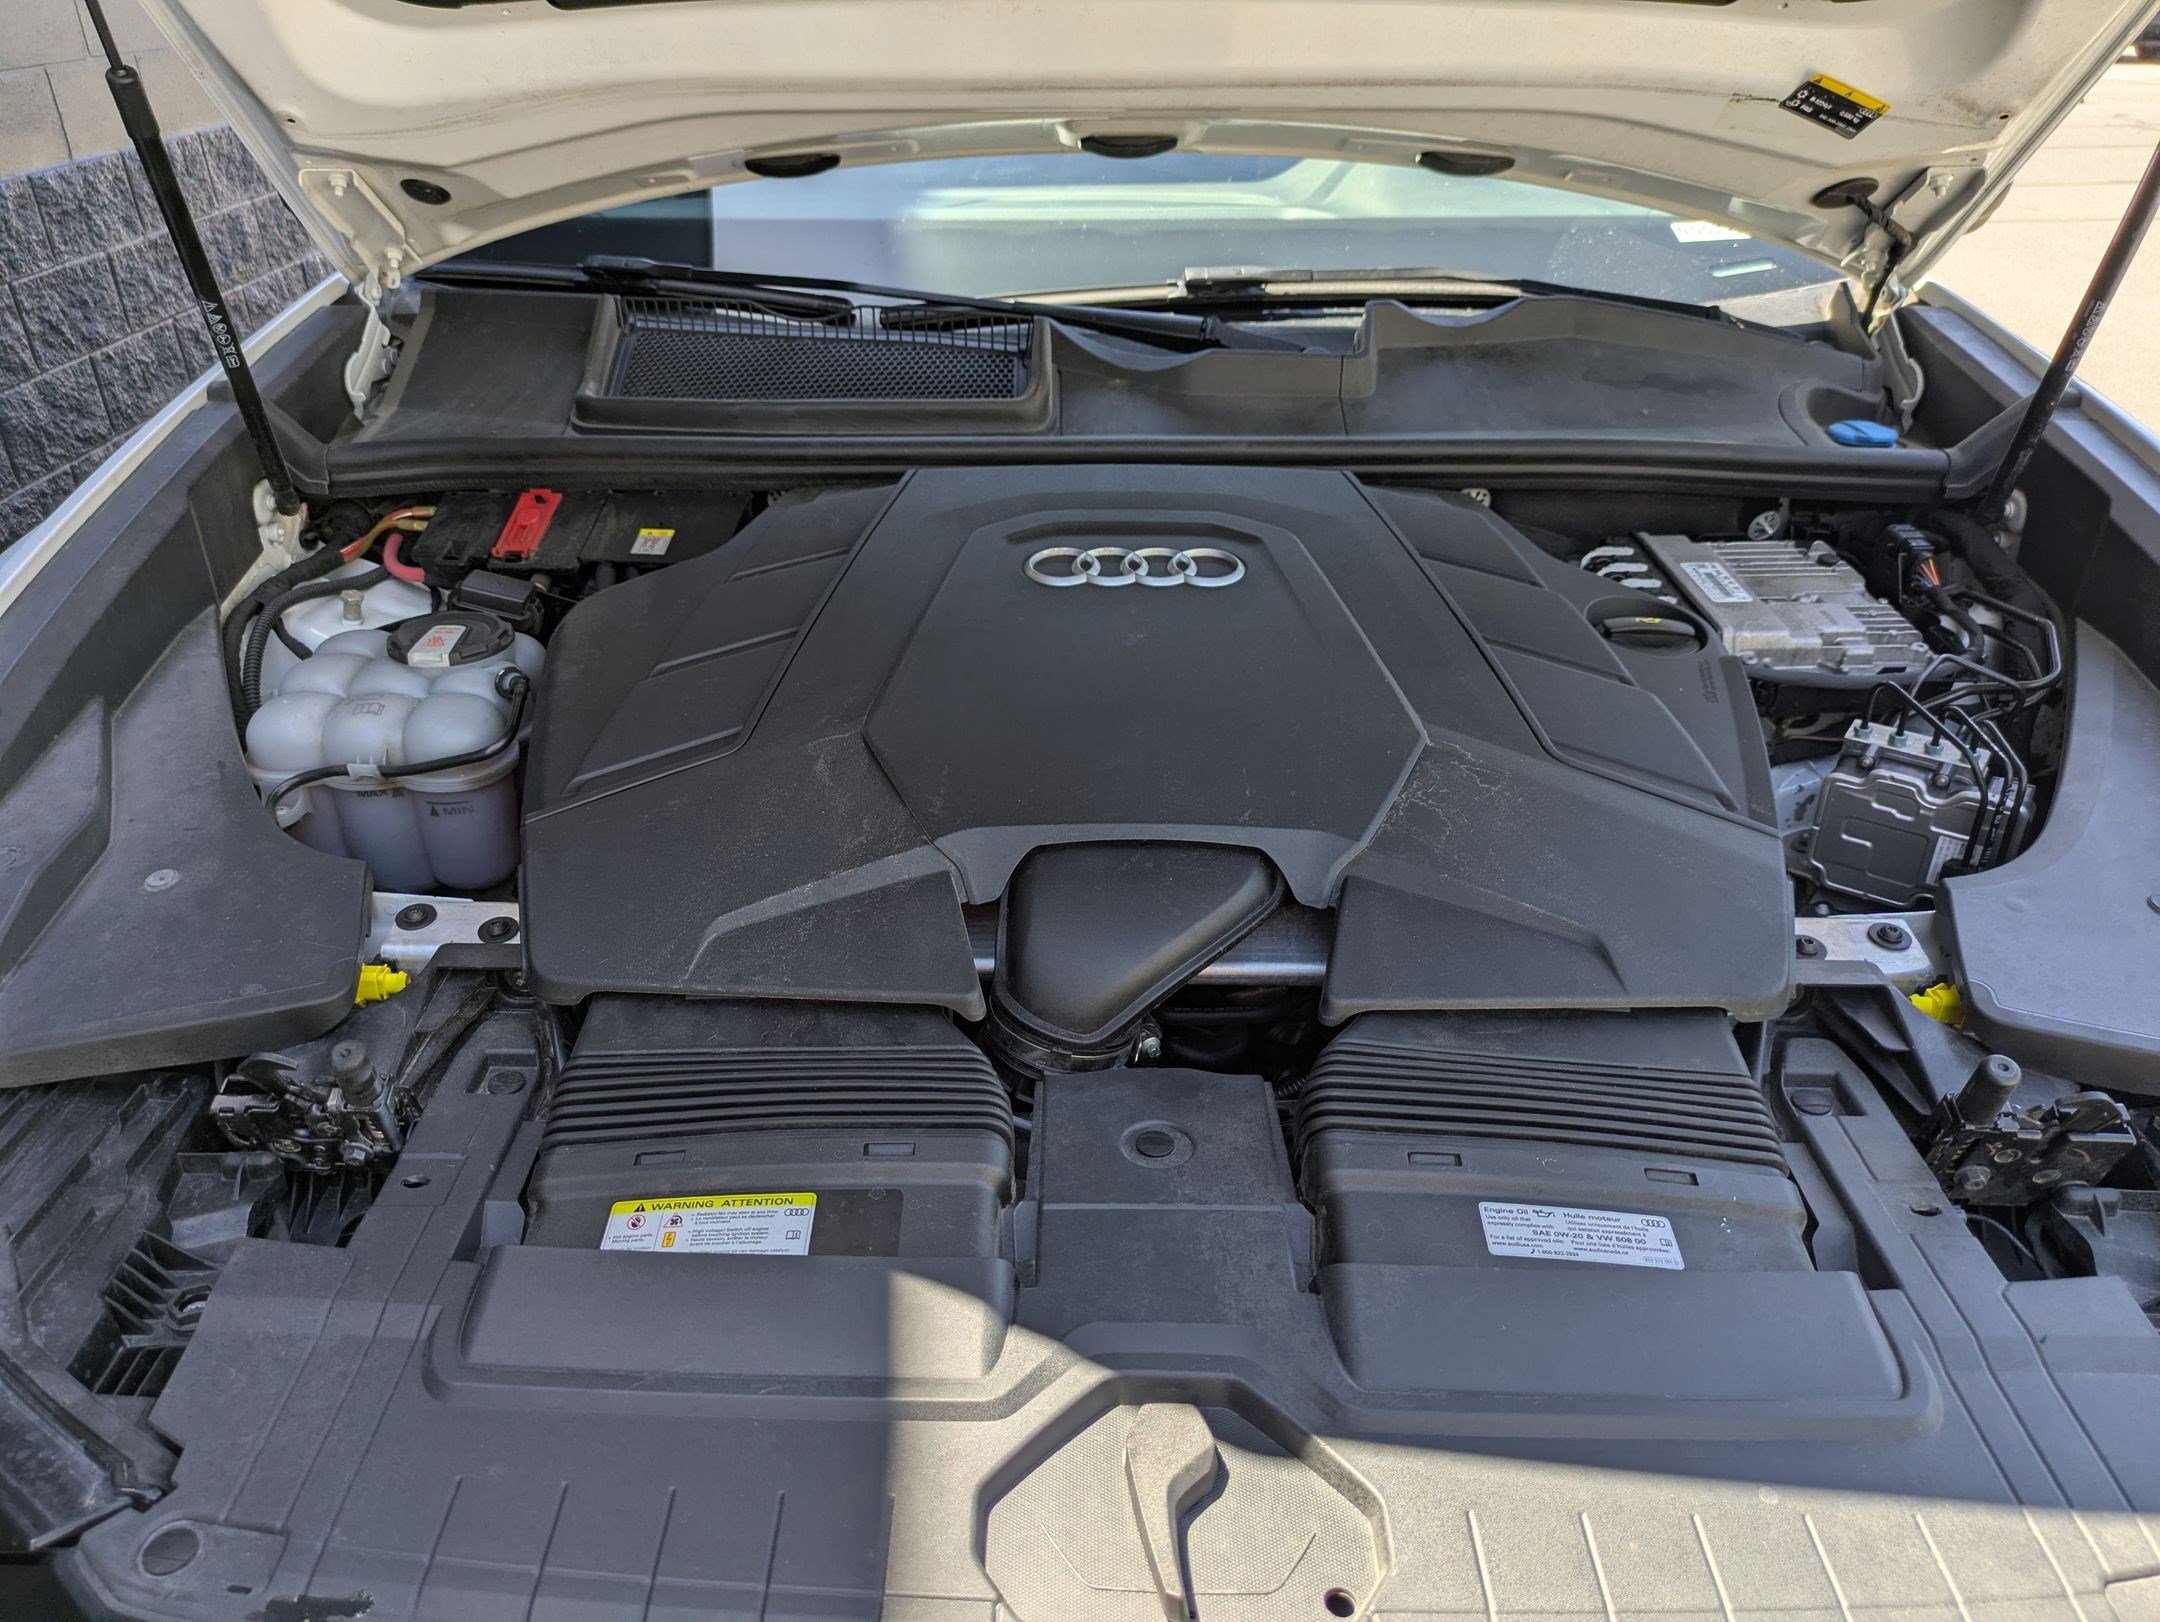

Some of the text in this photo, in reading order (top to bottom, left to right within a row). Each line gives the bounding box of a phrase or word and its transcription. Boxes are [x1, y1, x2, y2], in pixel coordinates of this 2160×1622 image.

[356, 790, 388, 798] MAX
[443, 804, 474, 816] MIN
[651, 1197, 794, 1210] WARNING ATTENTION
[1484, 1206, 1513, 1214] Engine
[1563, 1212, 1585, 1220] Huile
[1554, 1231, 1584, 1239] 0W-20
